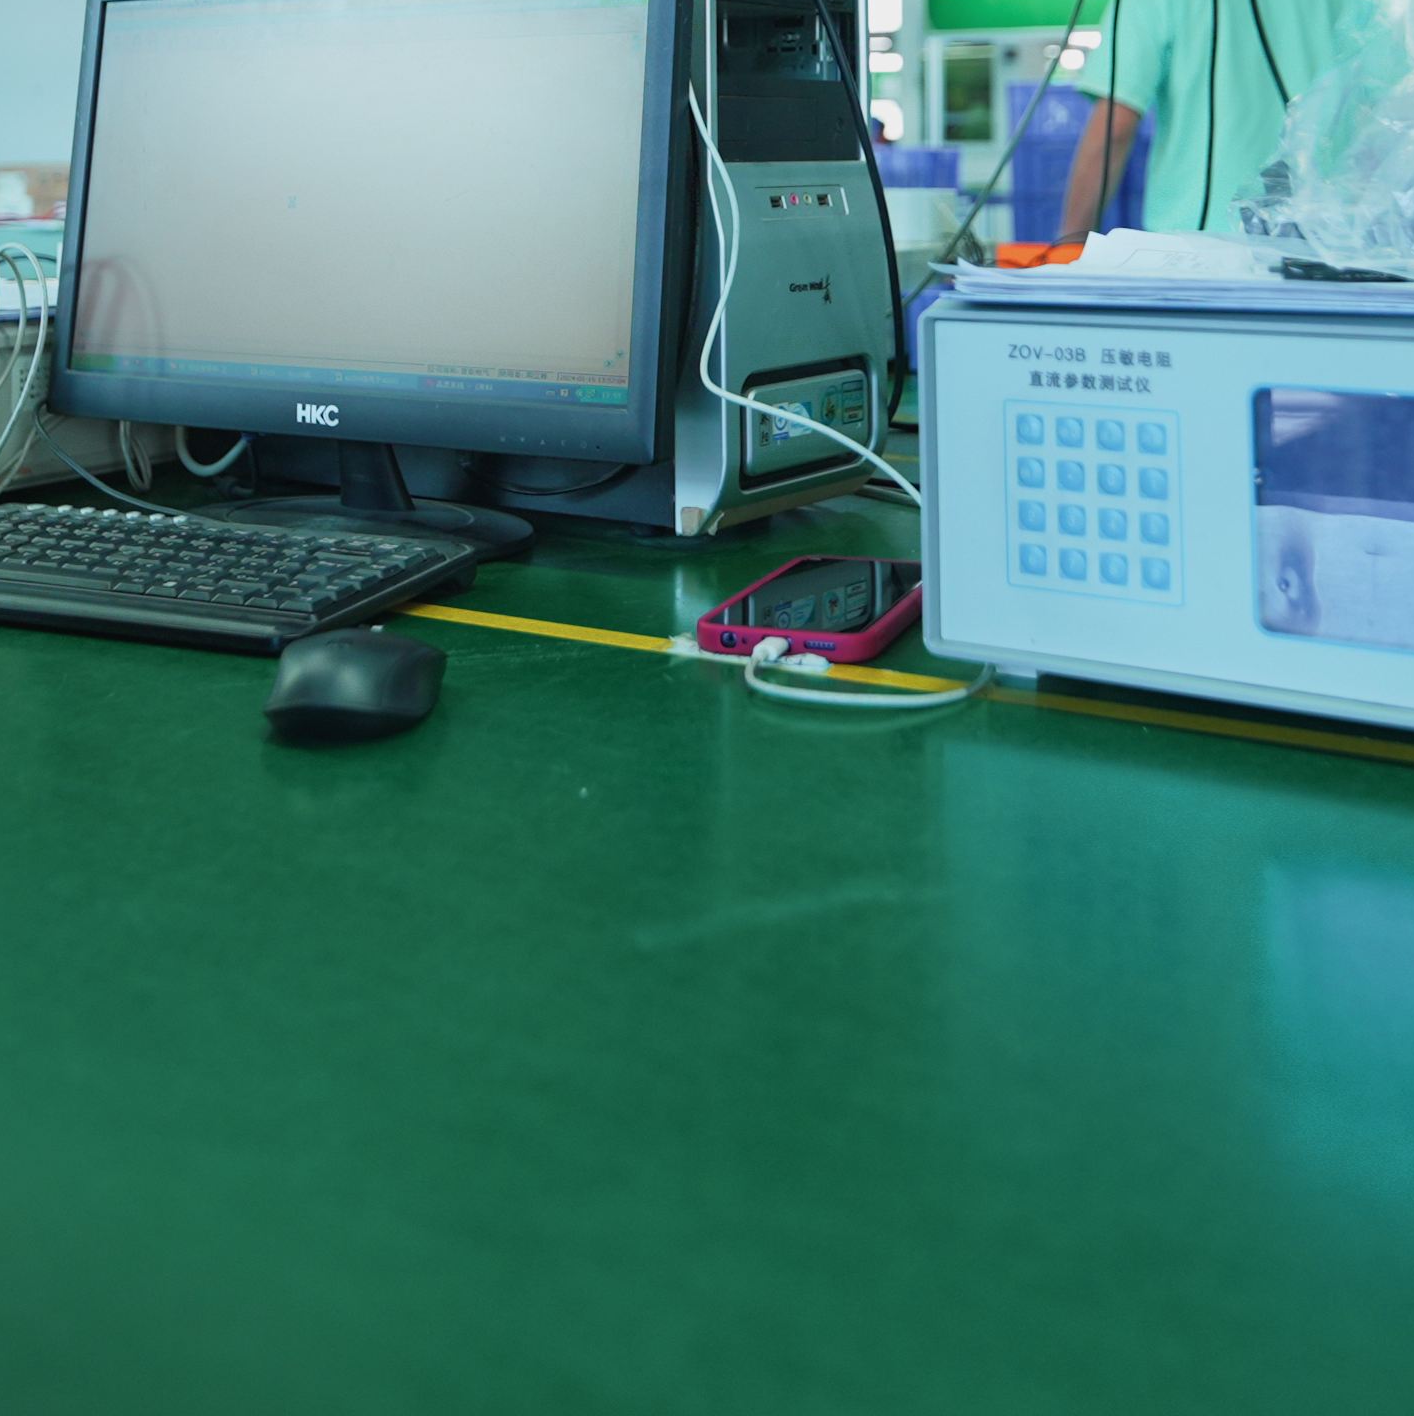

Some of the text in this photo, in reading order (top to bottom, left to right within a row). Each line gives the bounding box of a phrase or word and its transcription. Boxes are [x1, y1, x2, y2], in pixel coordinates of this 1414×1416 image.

[1008, 344, 1173, 368] ZOV-03B 压敏电阻
[1029, 370, 1152, 394] 直流参数测试仪
[296, 402, 339, 427] HKC
